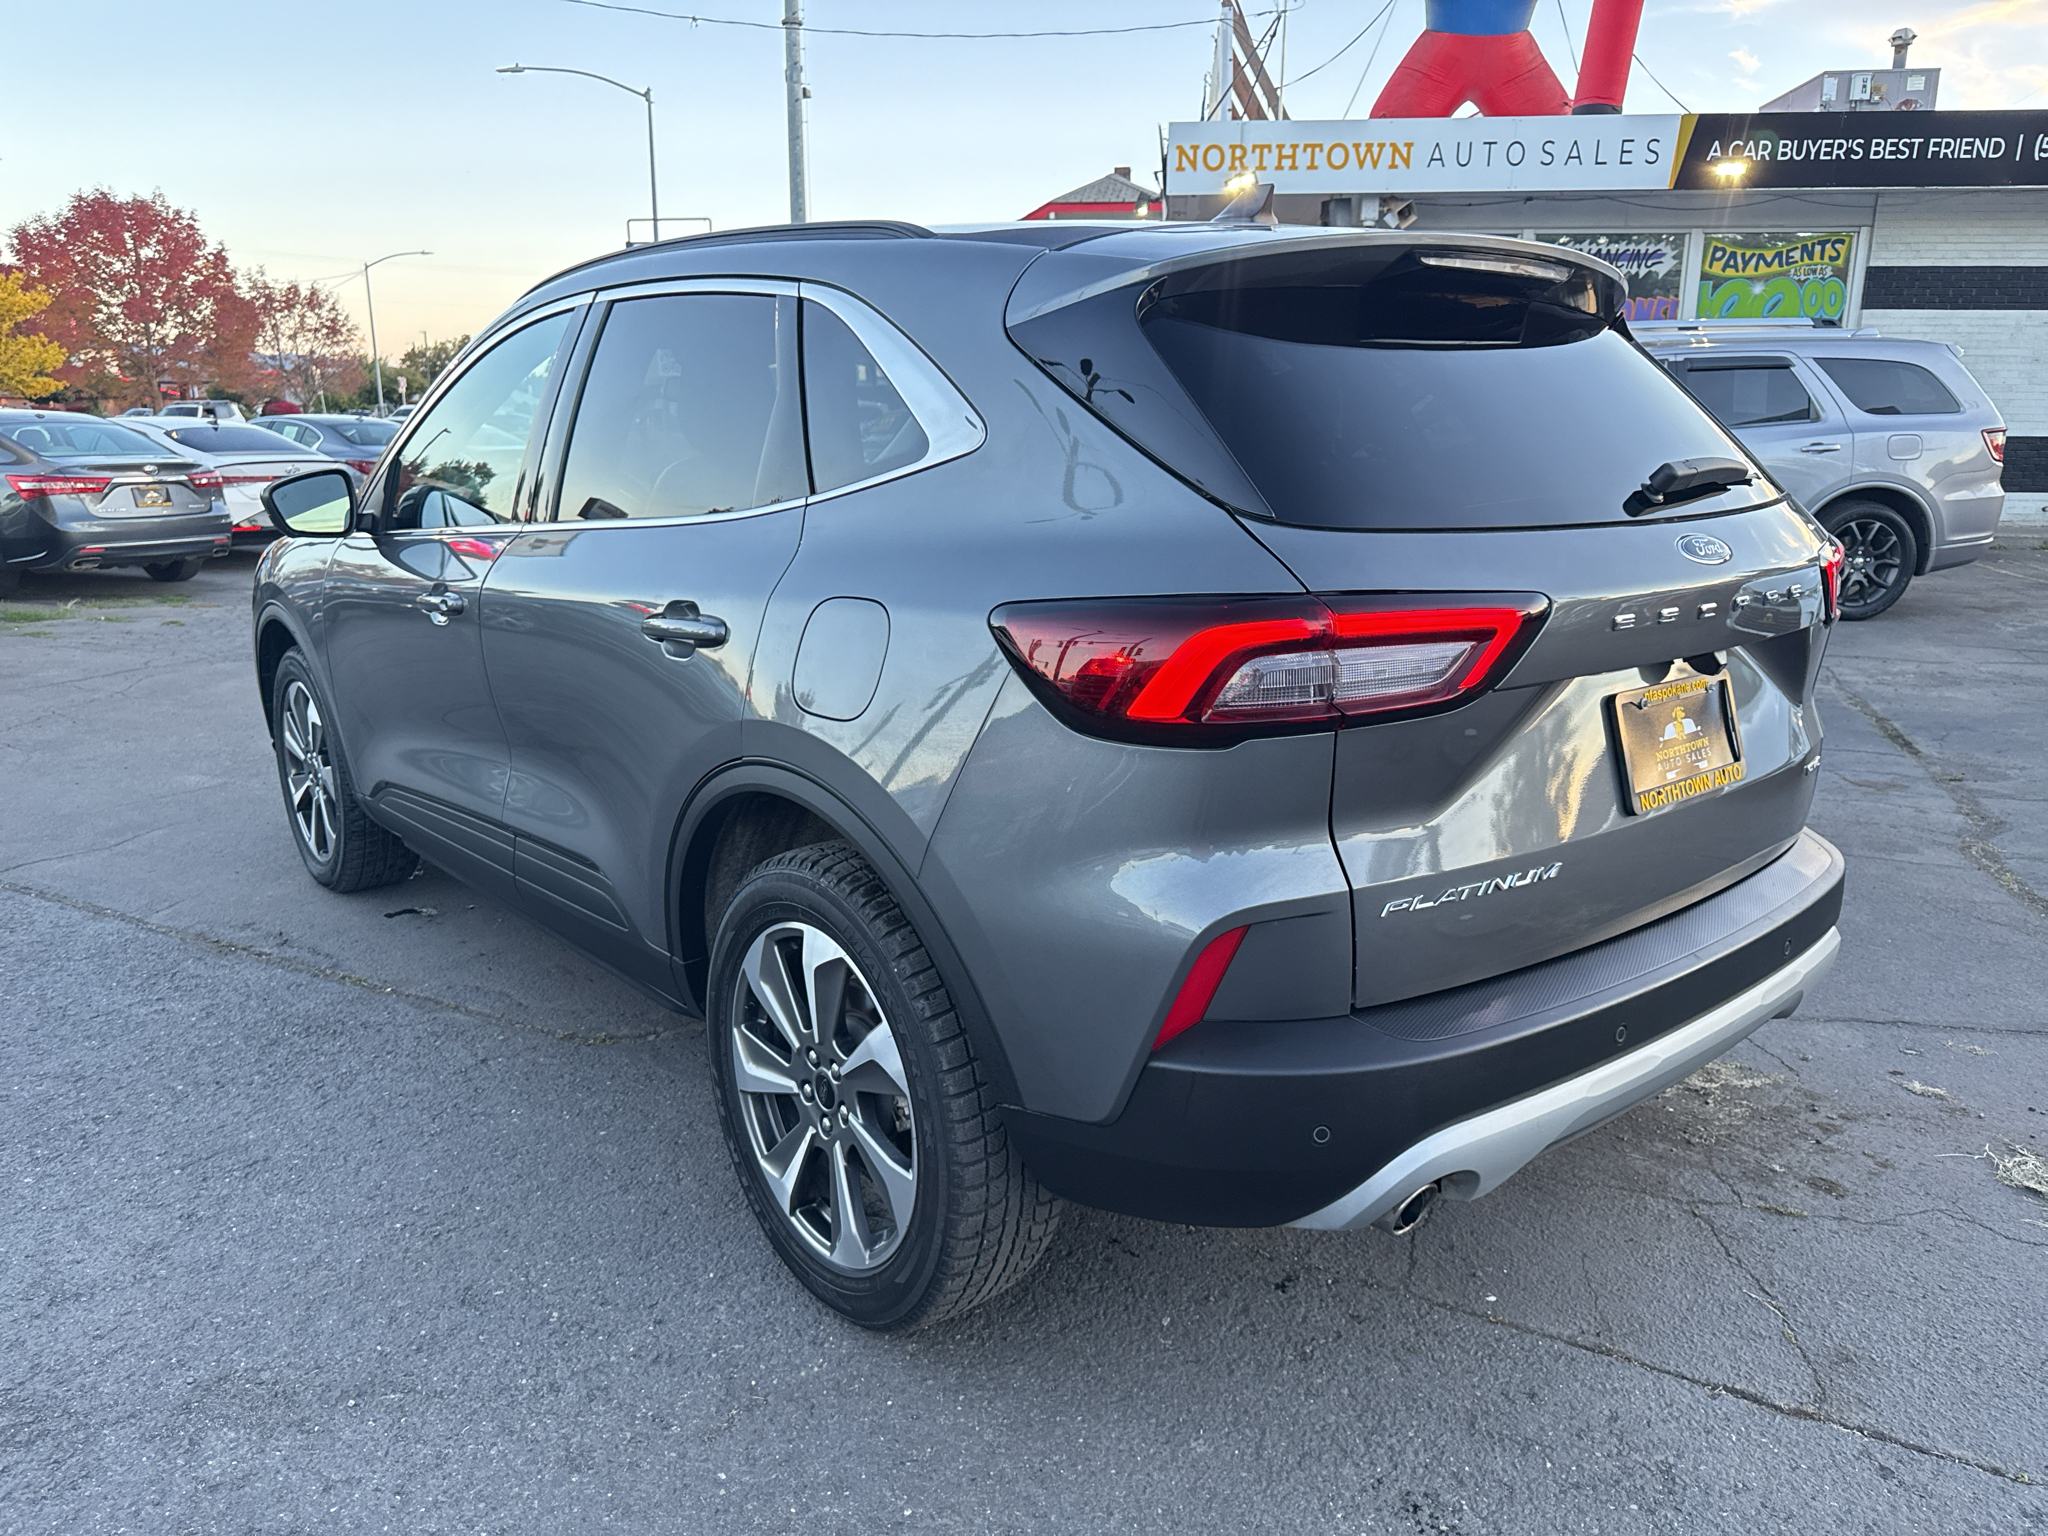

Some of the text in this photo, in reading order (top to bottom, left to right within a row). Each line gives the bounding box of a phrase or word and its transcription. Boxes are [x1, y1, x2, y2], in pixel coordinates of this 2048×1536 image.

[1175, 138, 1661, 172] NORTHTOWN AUTO SALES
[1706, 140, 1721, 161] A
[1729, 140, 1771, 161] CAR
[1777, 138, 1864, 160] BUYER'S
[1869, 138, 1924, 160] BEST
[1927, 137, 2005, 159] FRIEND
[1576, 248, 1664, 269] ANCING
[1708, 238, 1846, 273] PAYMENTS
[1803, 267, 1818, 277] LOW
[1691, 538, 1724, 556] Ford
[1612, 583, 1802, 631] ESCAPE
[1643, 678, 1708, 702] ntaspokane.com
[1655, 736, 1710, 762] NORTHTOWN
[1657, 747, 1712, 772] AUTO SALES
[1640, 763, 1742, 812] NORTHTOWN AUTO
[1380, 861, 1564, 918] PLATINUM
